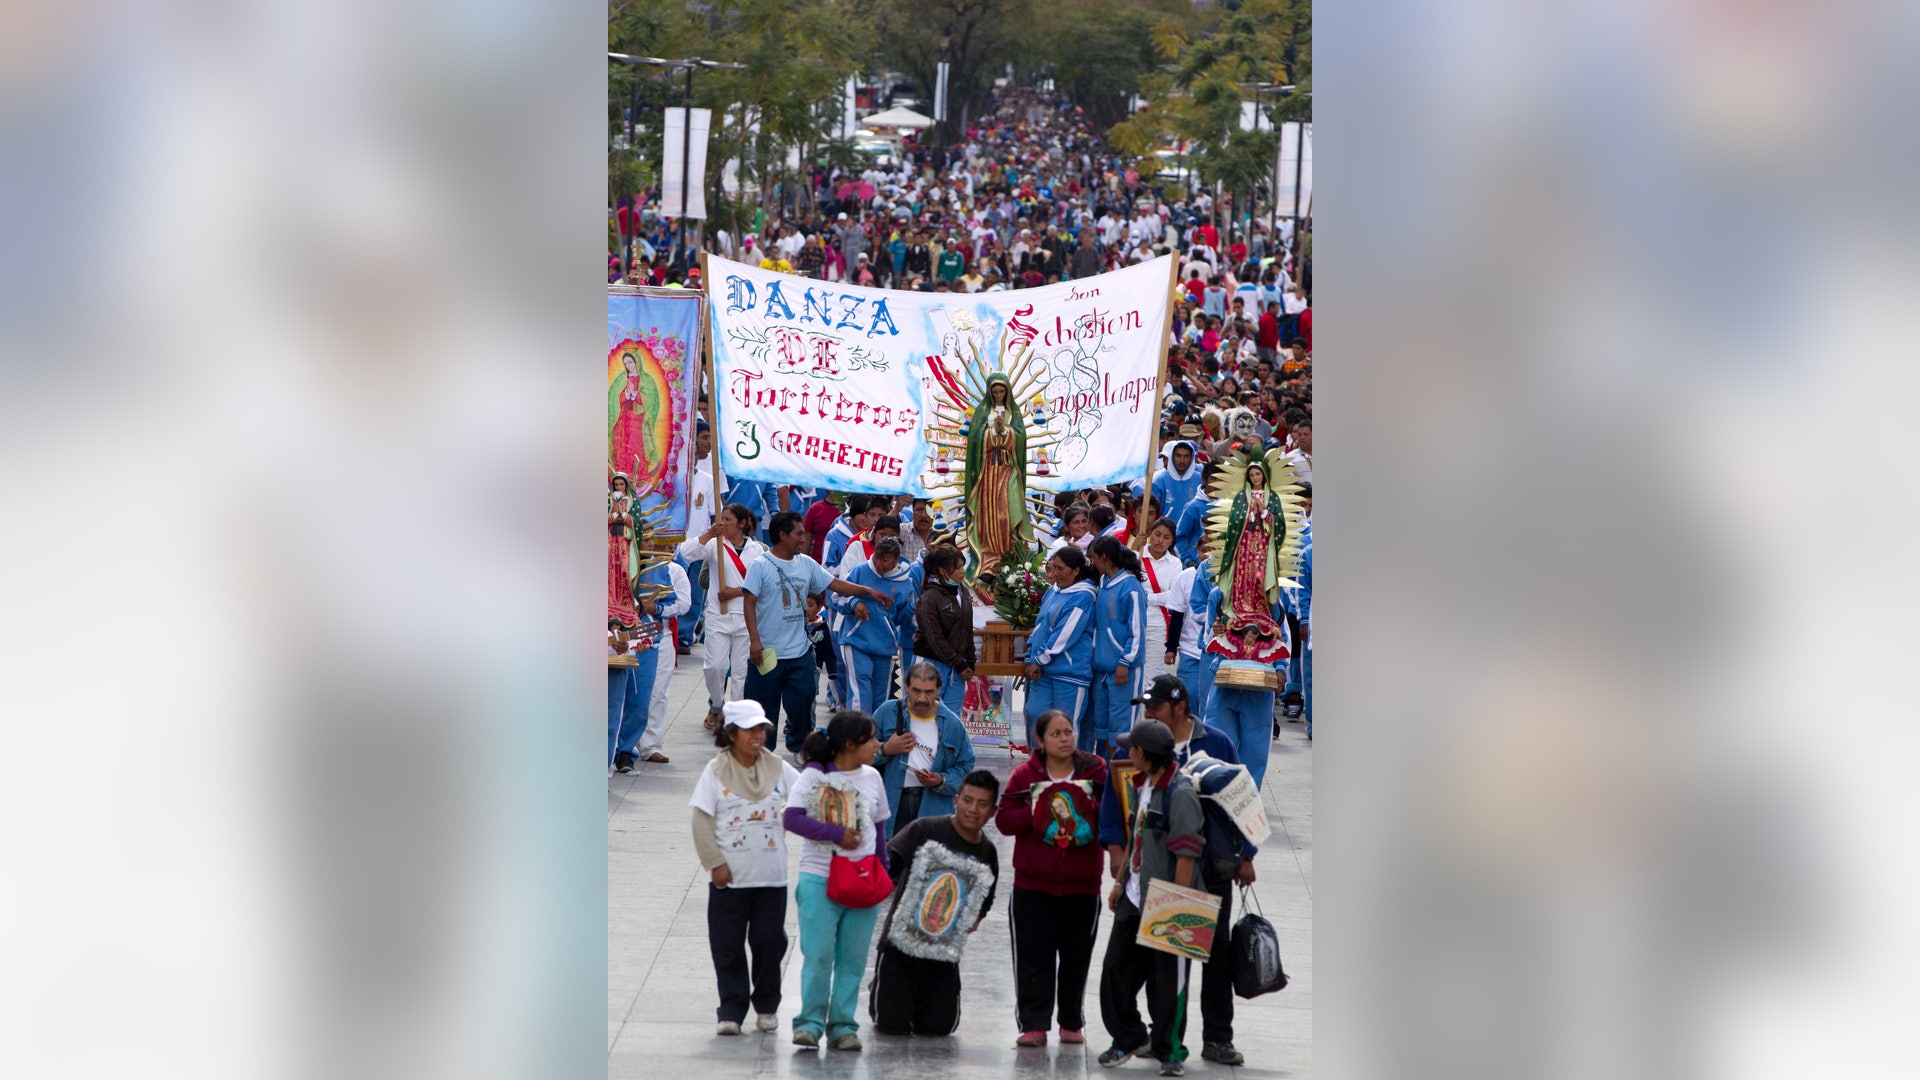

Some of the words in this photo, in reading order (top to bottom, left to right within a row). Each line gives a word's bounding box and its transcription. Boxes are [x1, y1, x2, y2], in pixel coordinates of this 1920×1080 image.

[726, 275, 900, 338] DANZA
[775, 328, 841, 375] DE
[730, 369, 920, 437] Toriteros
[770, 430, 904, 477] GRASEJOS
